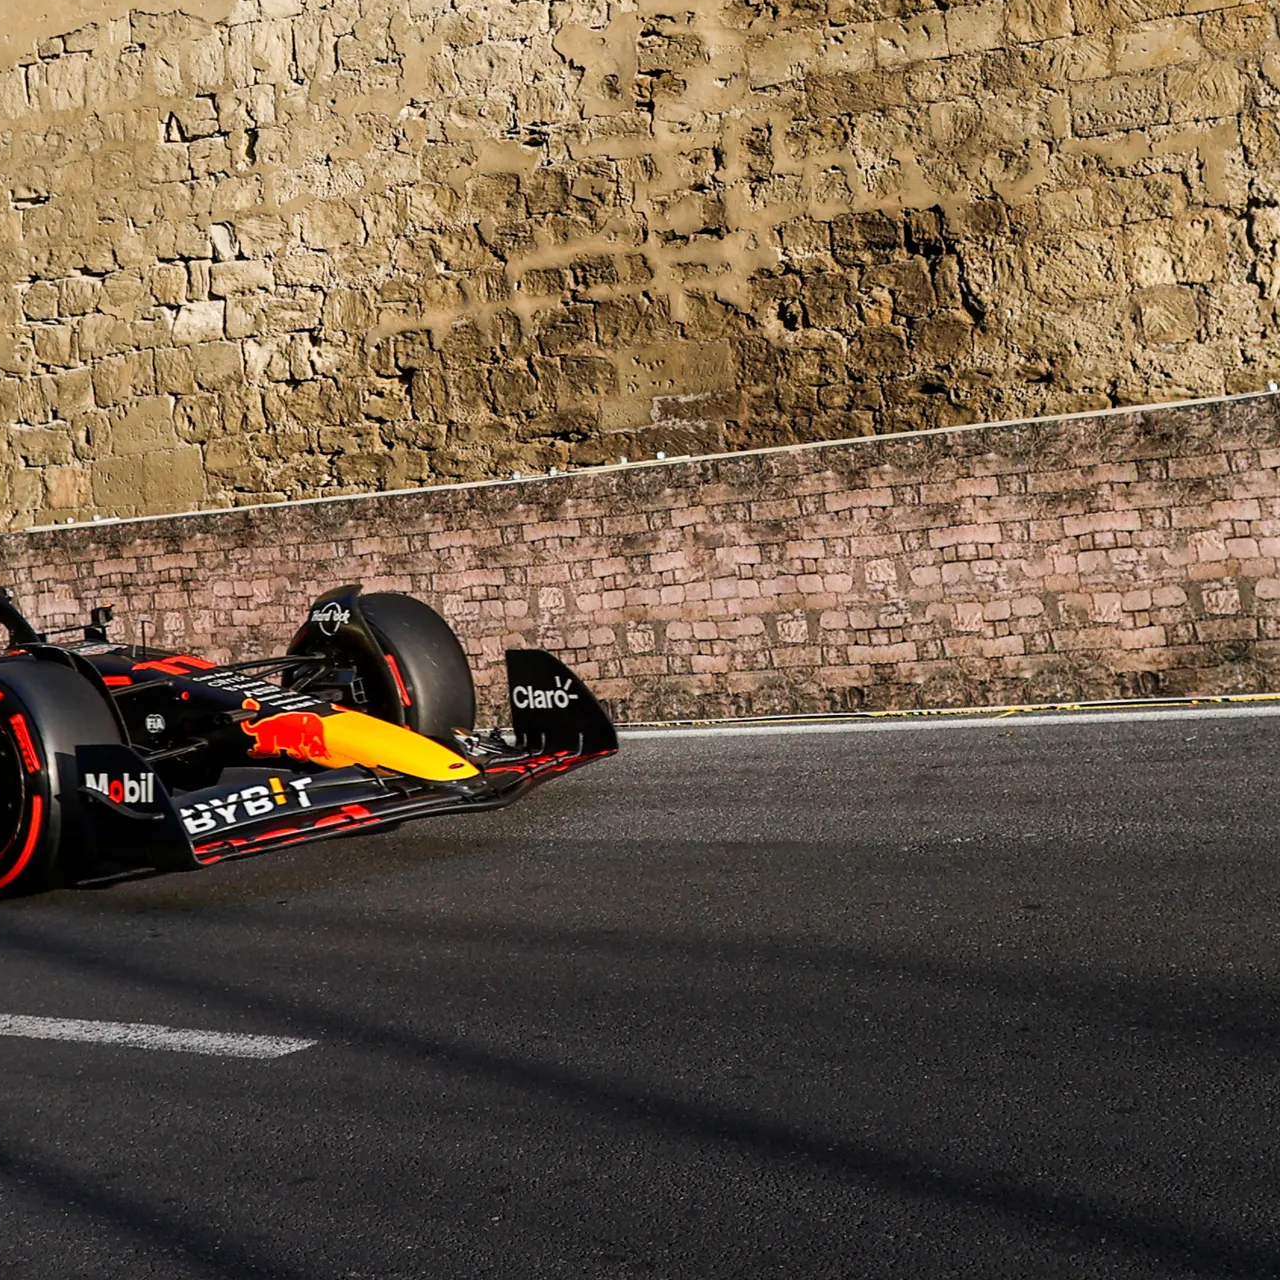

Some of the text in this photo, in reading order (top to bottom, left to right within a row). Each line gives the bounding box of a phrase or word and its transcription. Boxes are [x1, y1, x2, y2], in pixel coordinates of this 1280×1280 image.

[512, 685, 570, 710] Claro
[145, 715, 166, 732] FIA
[85, 773, 154, 804] Mobil
